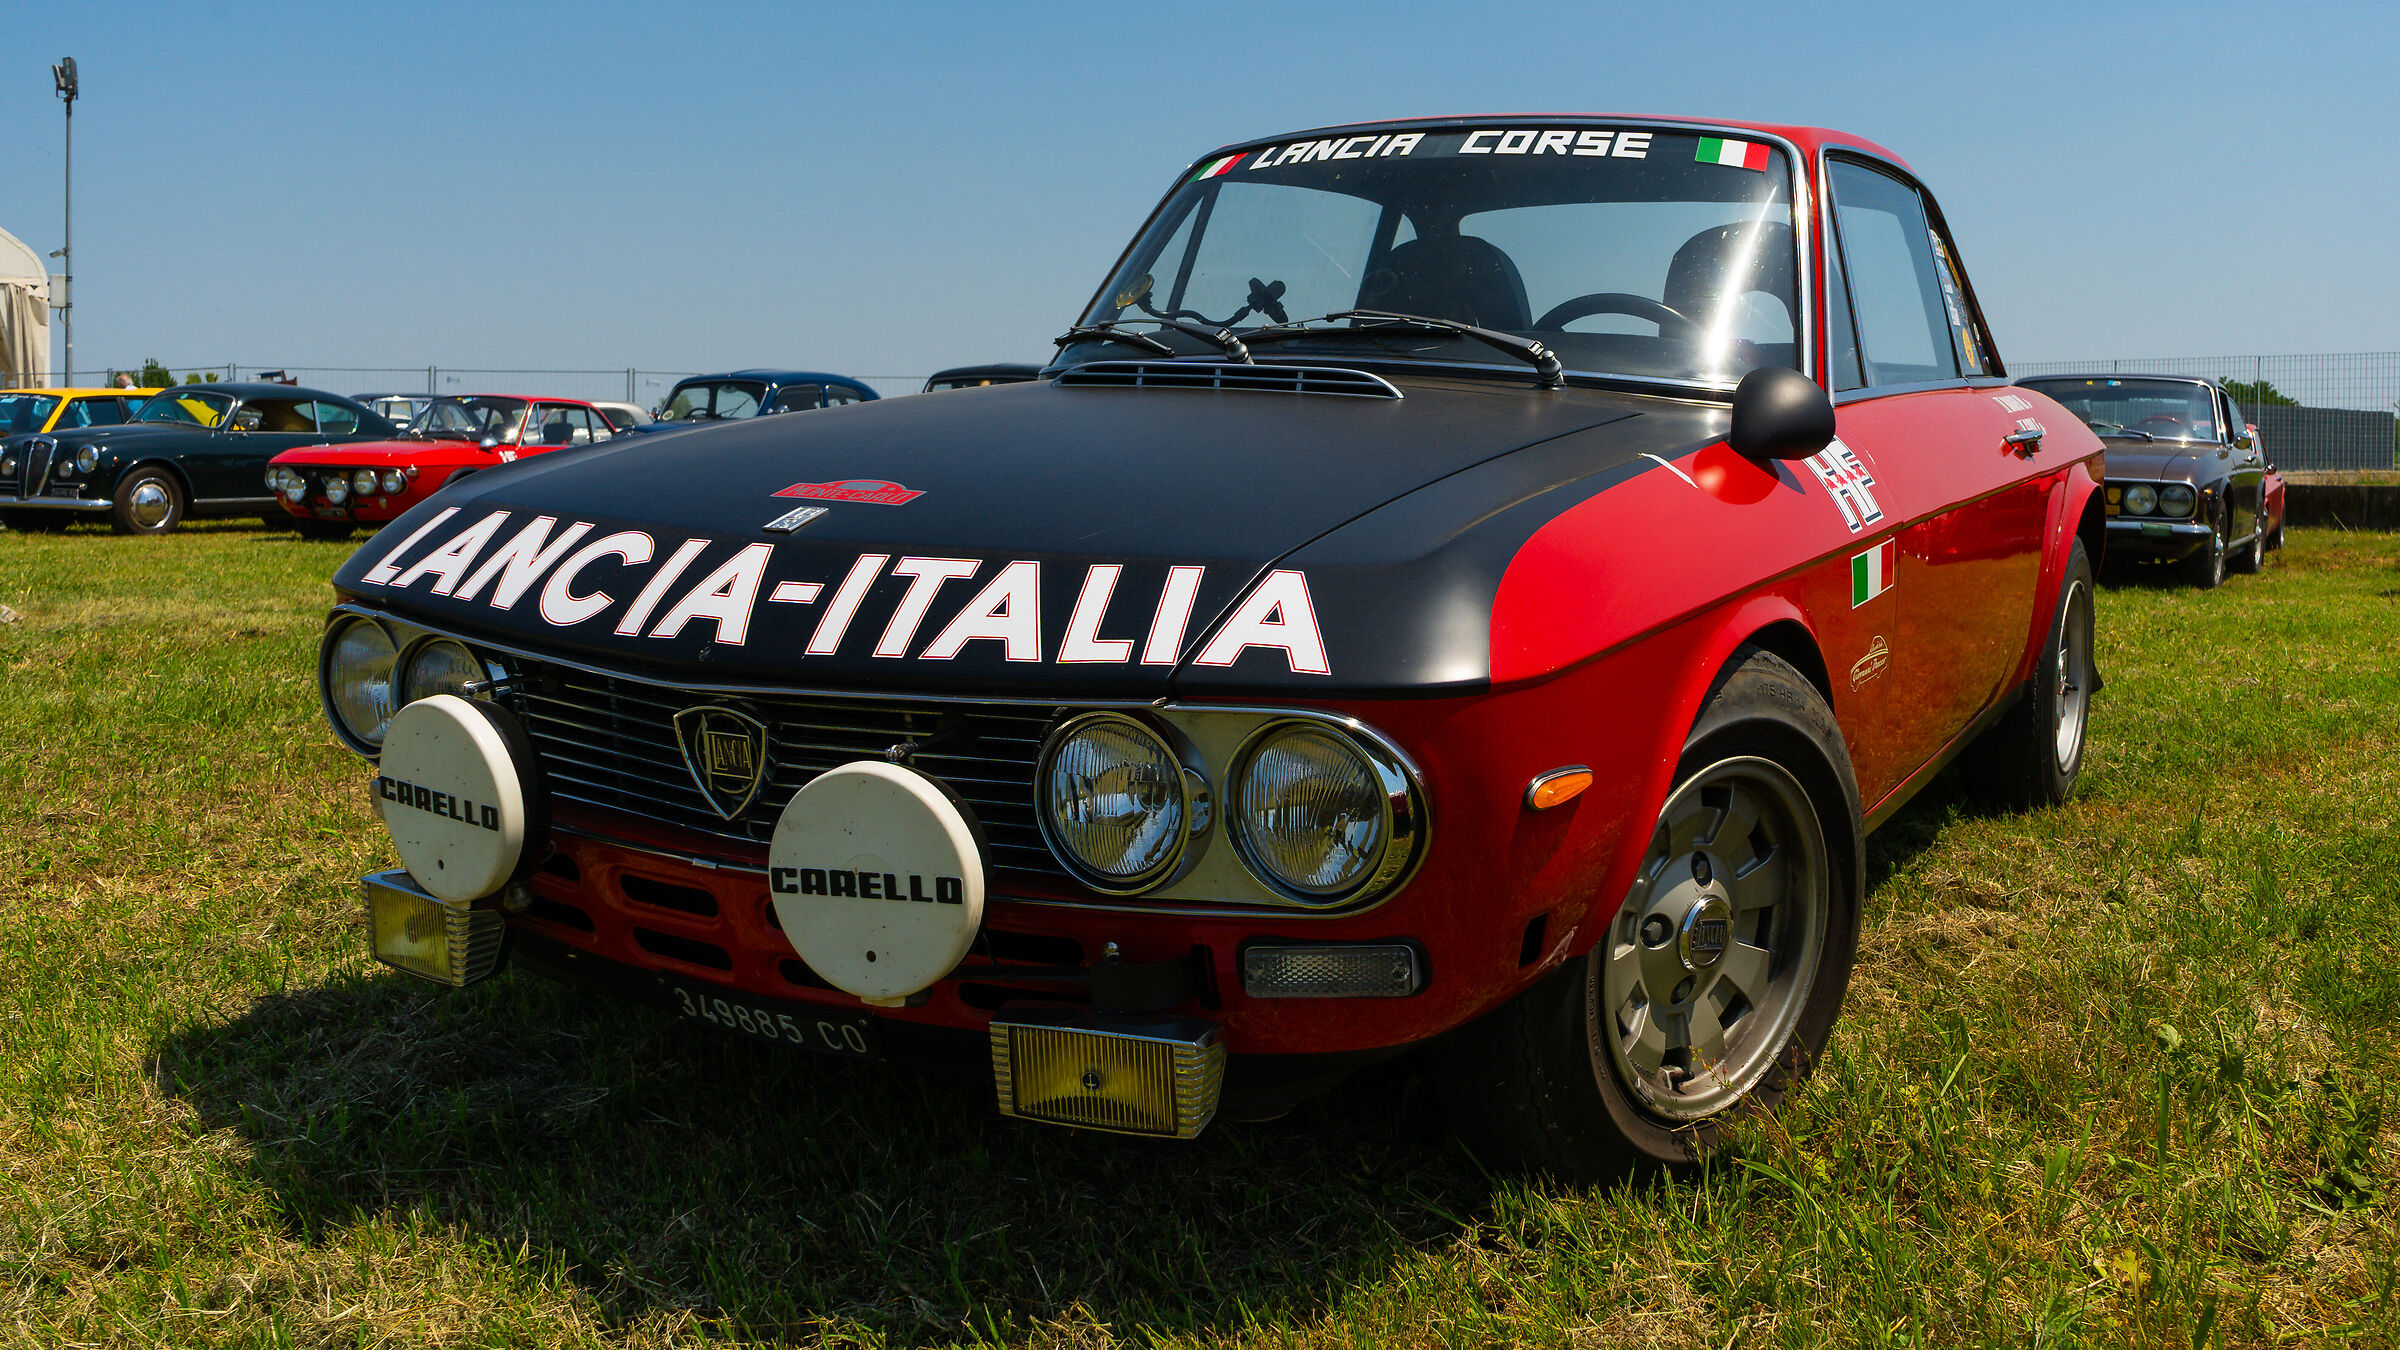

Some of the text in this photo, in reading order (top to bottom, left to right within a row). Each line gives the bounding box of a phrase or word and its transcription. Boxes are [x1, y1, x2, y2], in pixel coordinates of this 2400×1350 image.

[1249, 130, 1653, 171] LANCIA CORSE
[788, 485, 908, 503] MONTE-CARLO
[361, 507, 1331, 676] LANCIA-ITALIA
[711, 735, 751, 771] LANCIA
[380, 775, 499, 831] CARELLO
[771, 867, 964, 904] CARELLO
[674, 987, 867, 1053] 349885 CO
